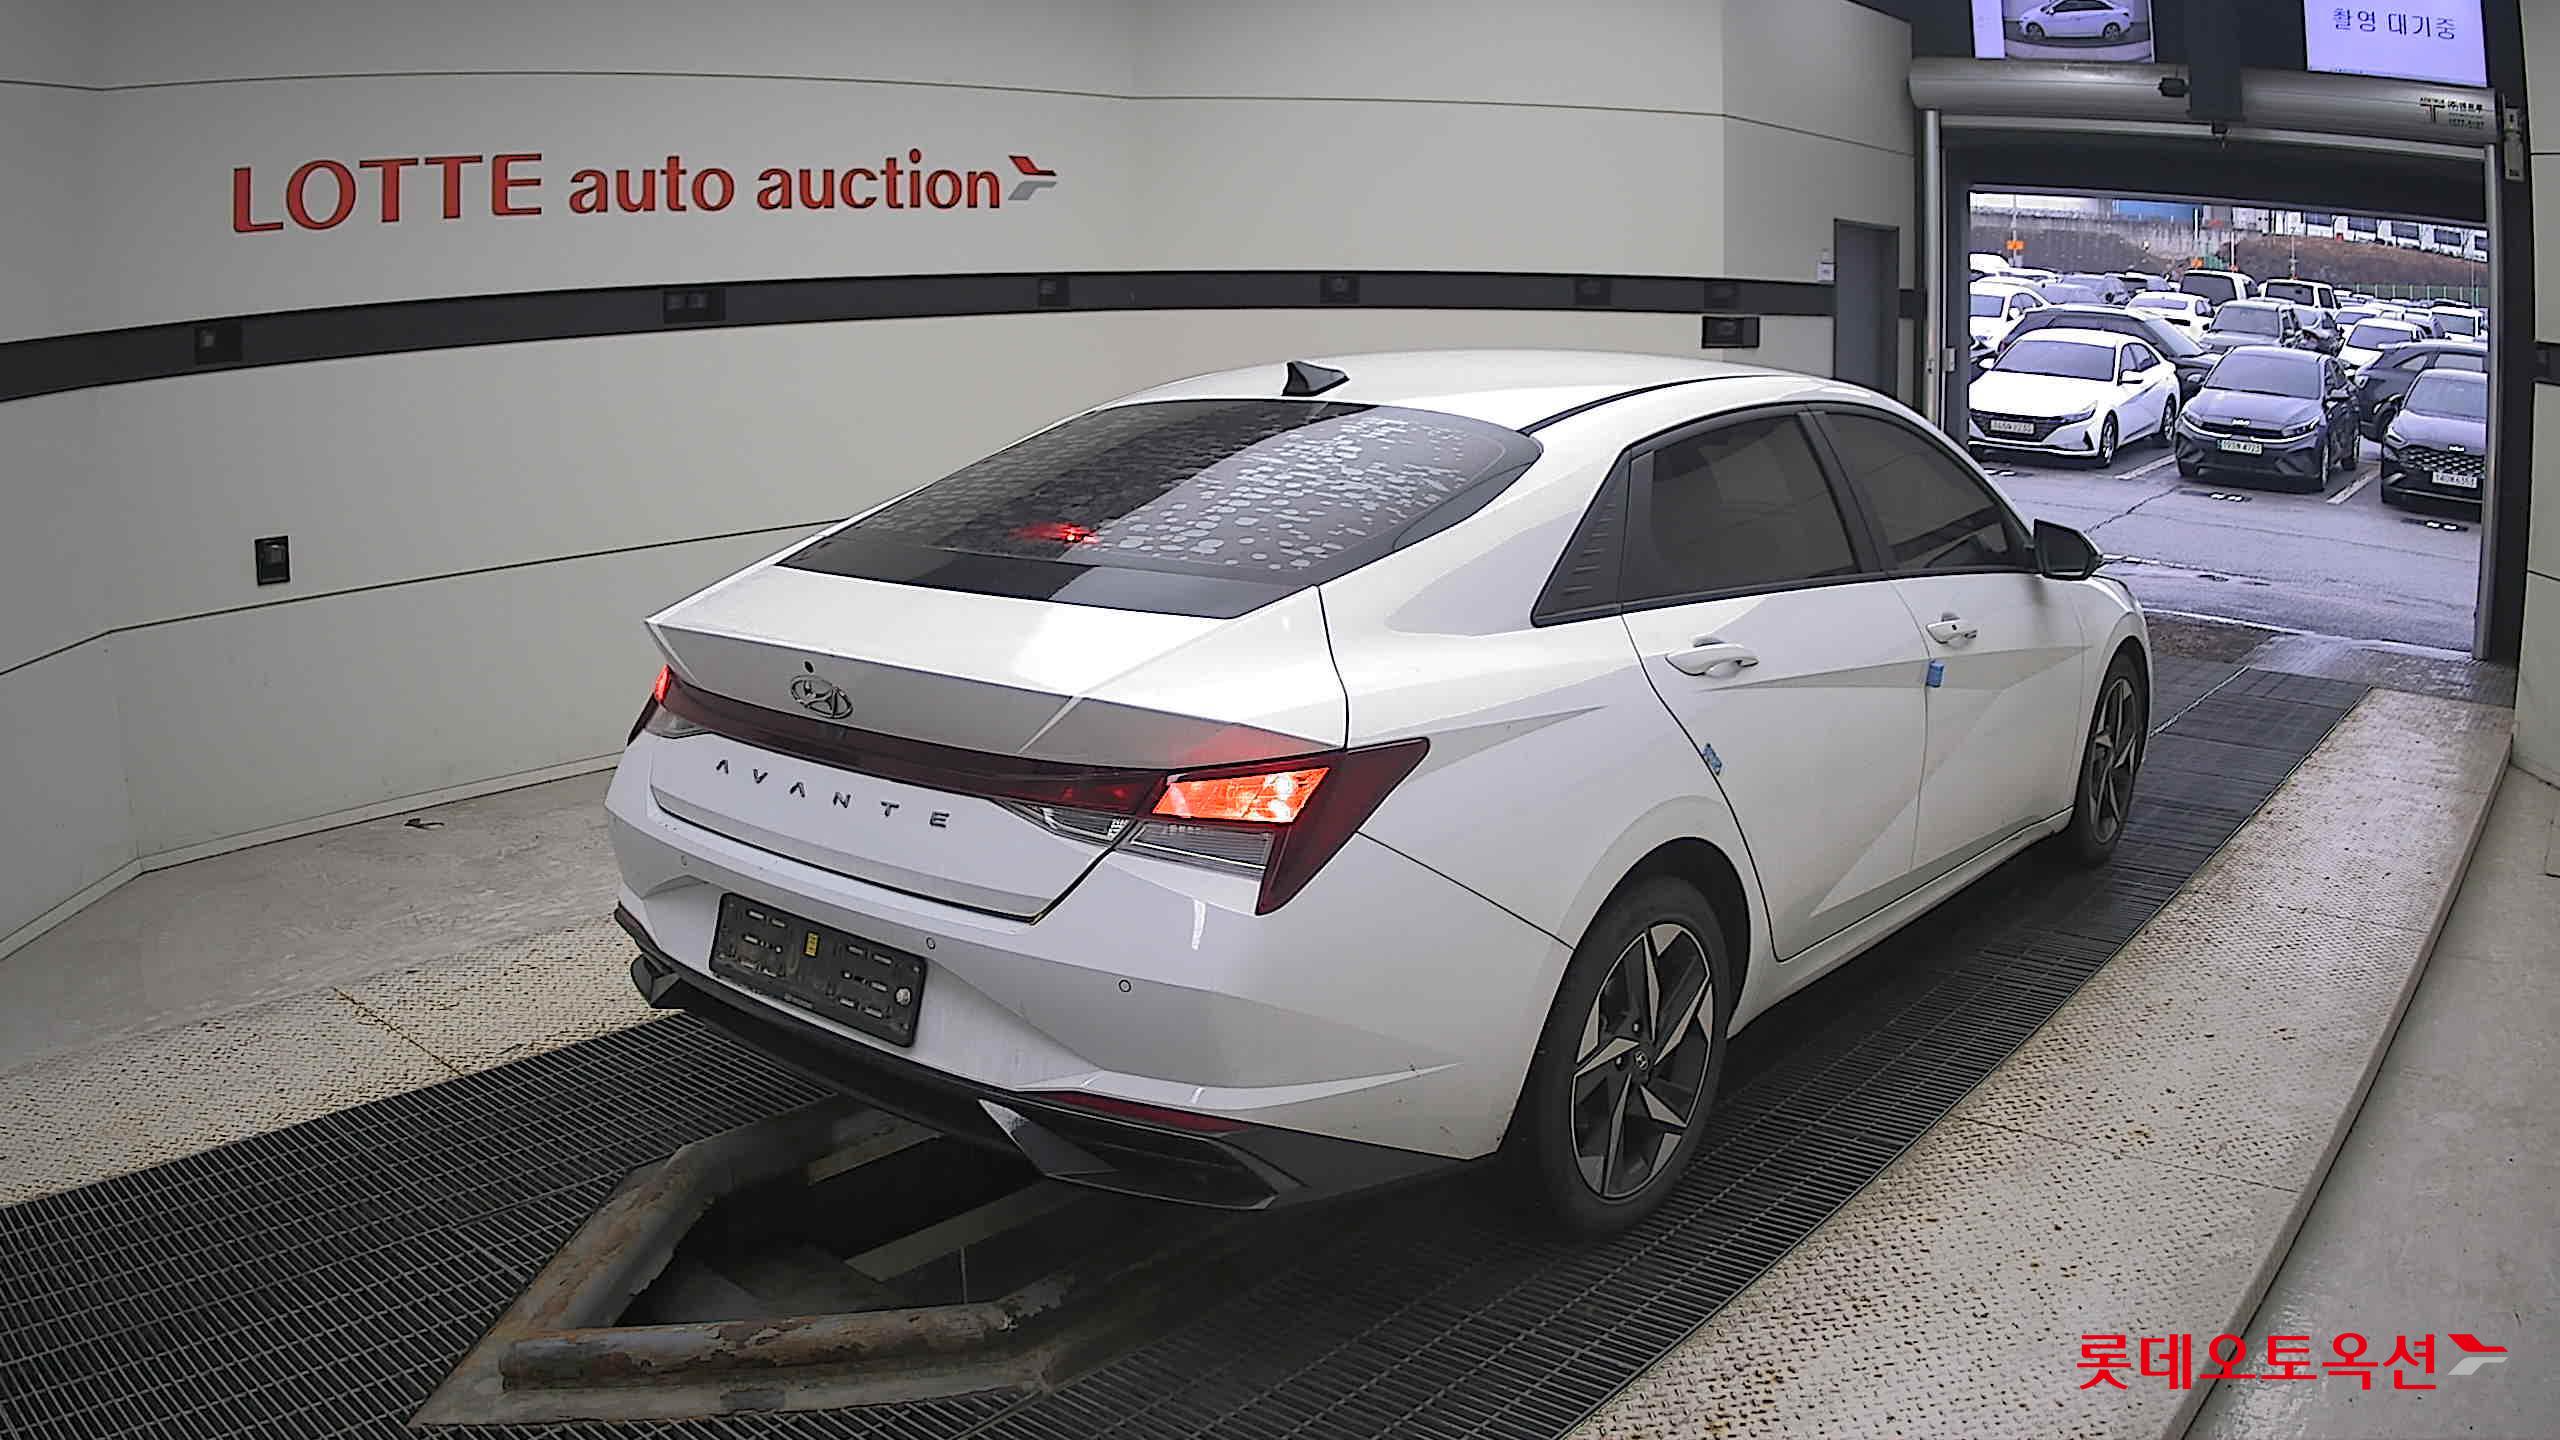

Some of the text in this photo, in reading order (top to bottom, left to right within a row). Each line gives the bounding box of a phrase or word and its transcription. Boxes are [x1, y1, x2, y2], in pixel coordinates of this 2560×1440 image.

[2333, 8, 2456, 40] 촬영 대기중
[233, 148, 1001, 233] LOTTE auto auction
[716, 759, 950, 828] AVANTE
